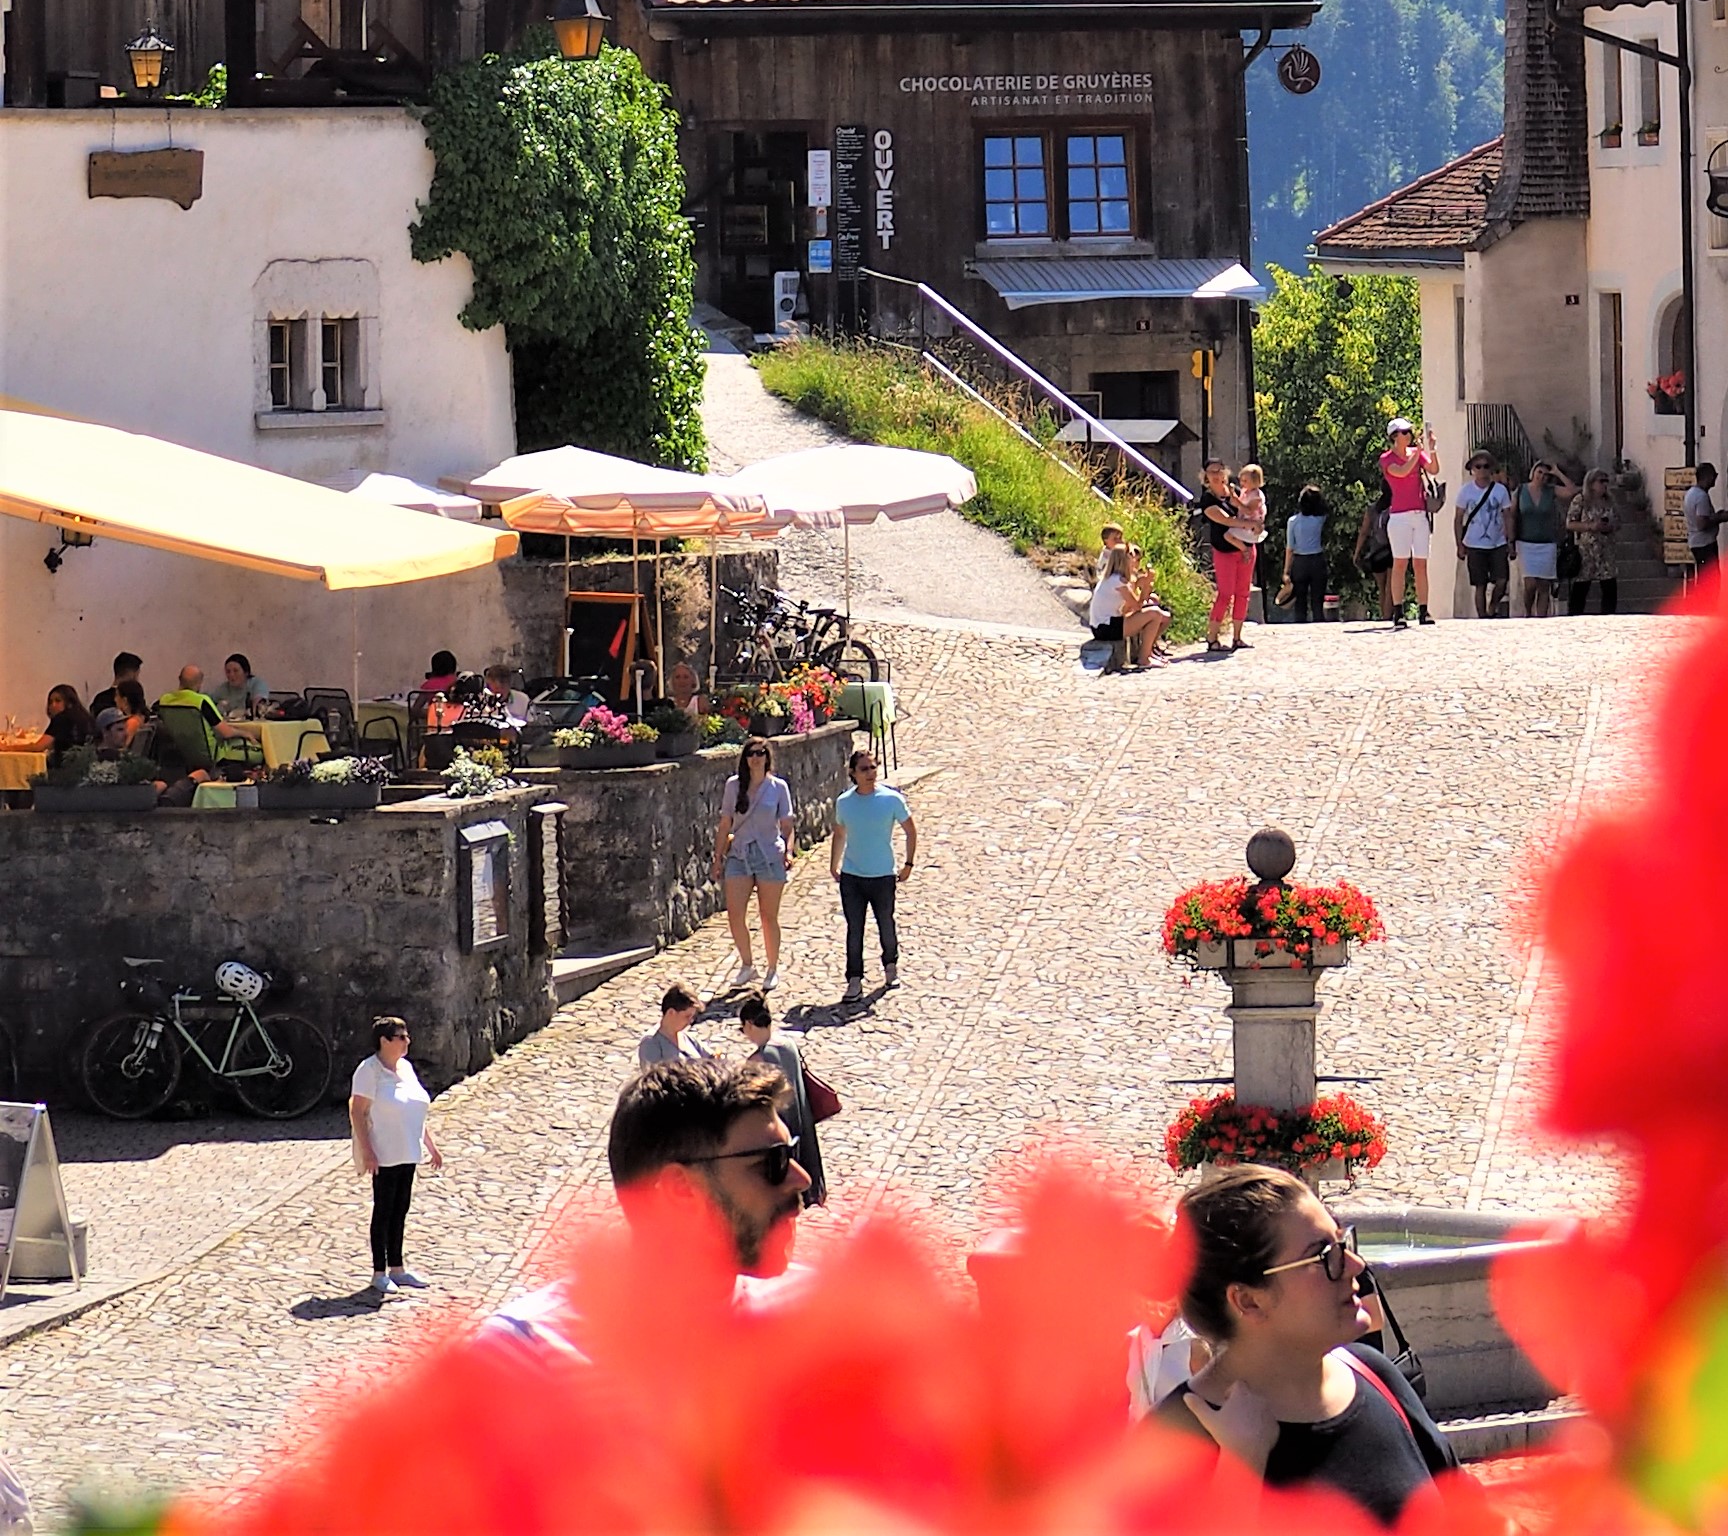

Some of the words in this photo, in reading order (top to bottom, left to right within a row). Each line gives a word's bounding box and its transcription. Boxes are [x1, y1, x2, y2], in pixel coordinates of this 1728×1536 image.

[899, 76, 1031, 92] CHOCOLATERIE
[1036, 75, 1059, 90] DE
[1063, 71, 1153, 89] GRUYÈRES
[971, 95, 1048, 106] ARTISANAT
[1055, 94, 1070, 105] ET
[1077, 93, 1153, 104] TRADITION
[874, 130, 895, 250] OUVERT
